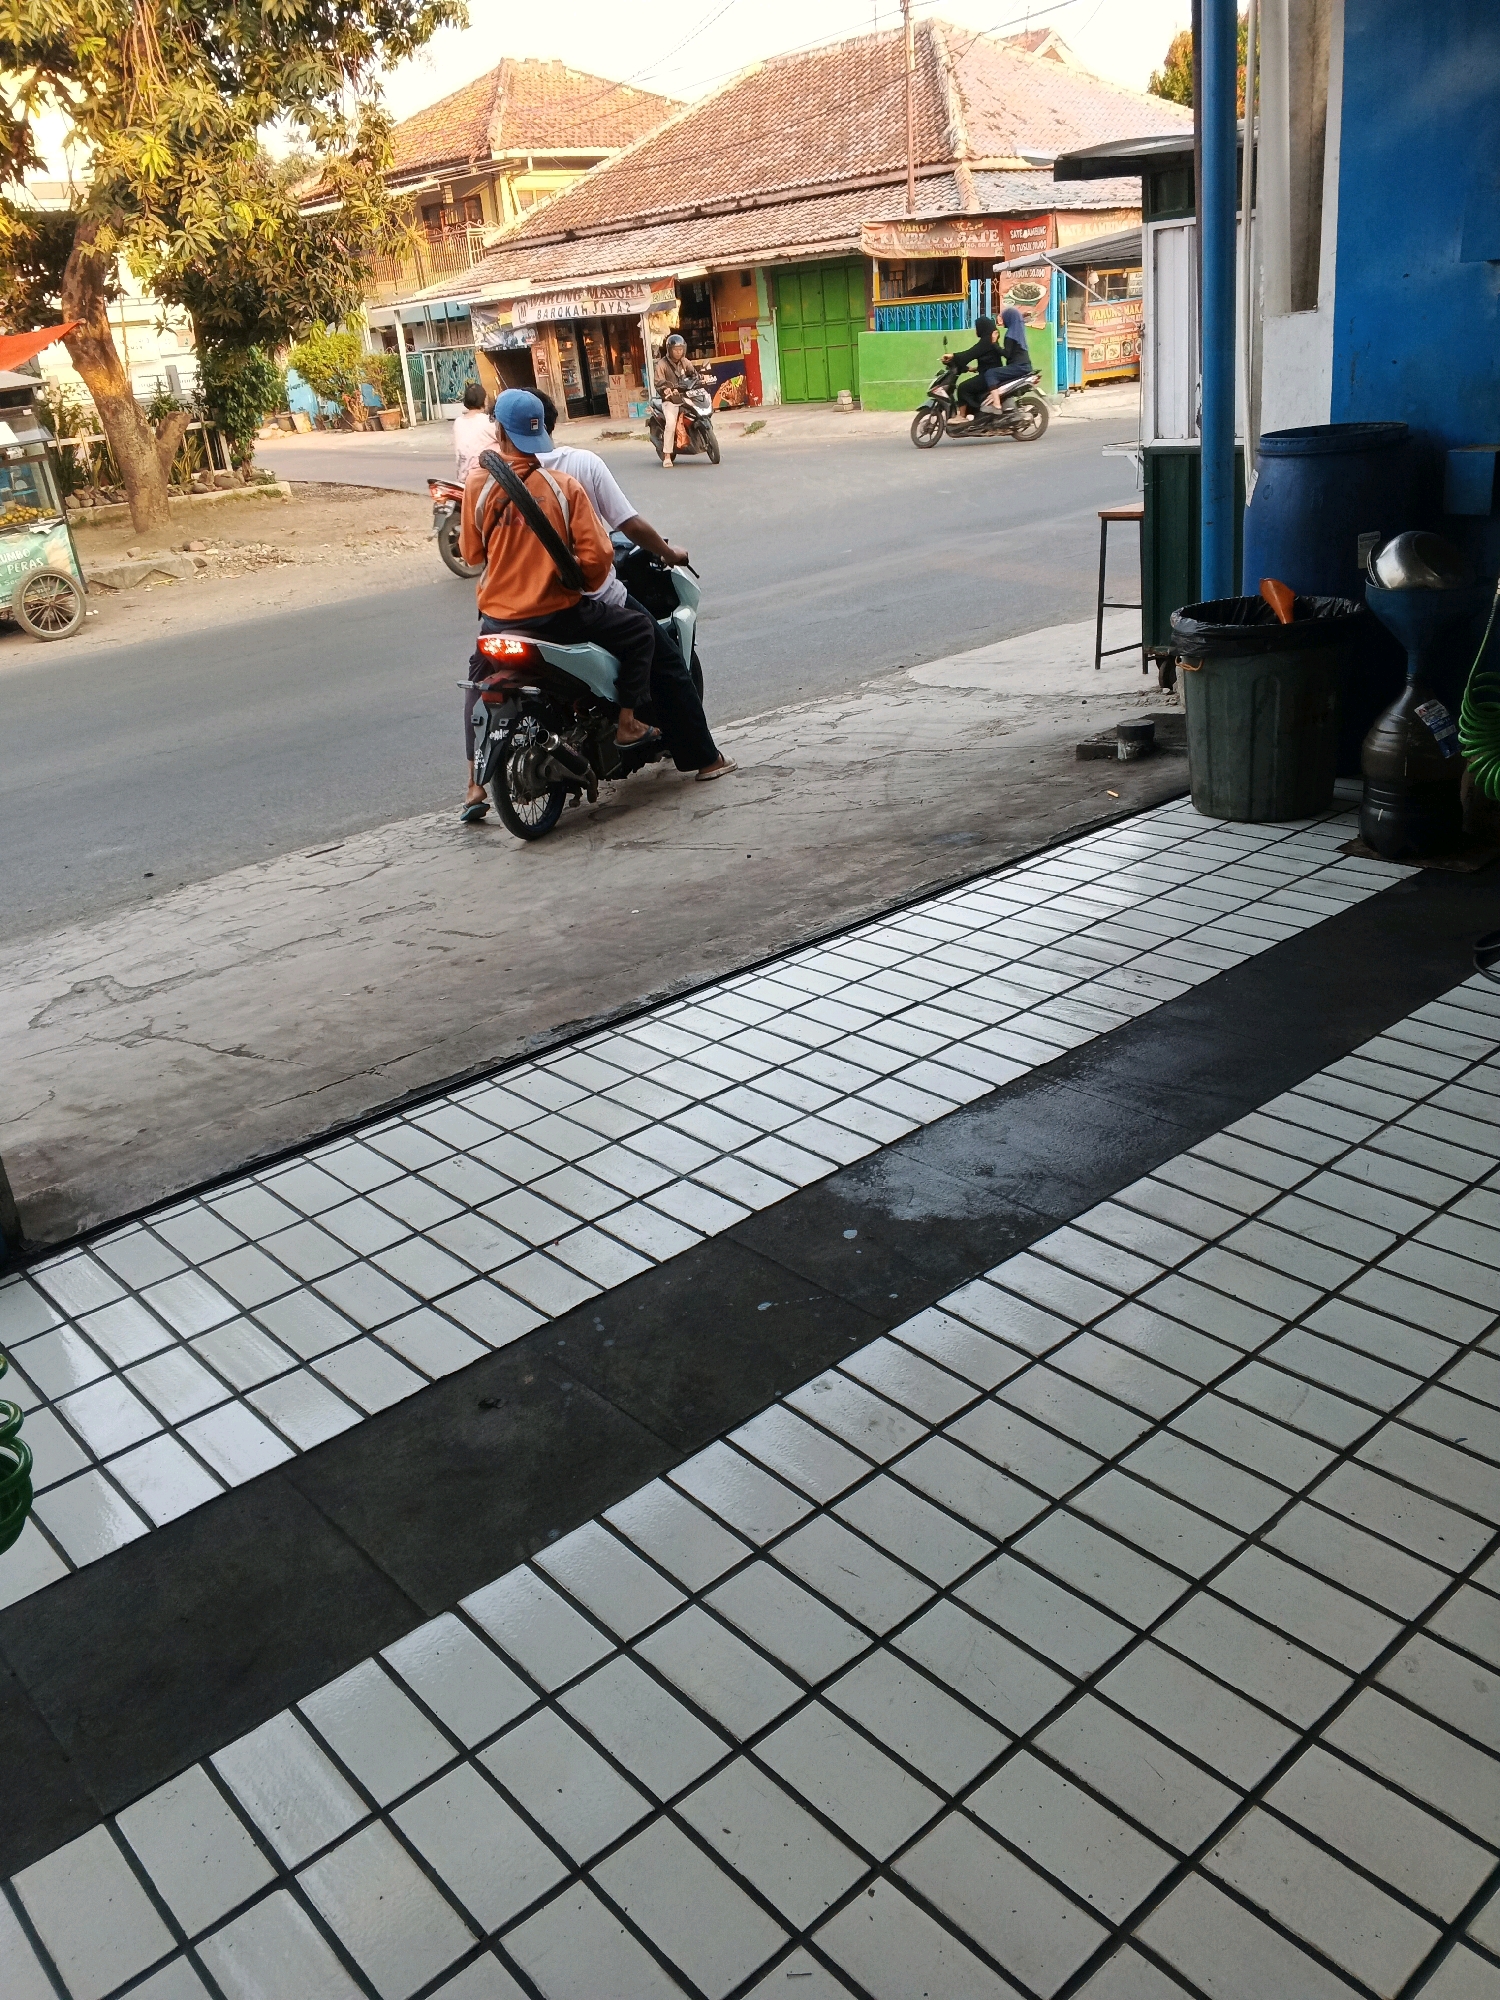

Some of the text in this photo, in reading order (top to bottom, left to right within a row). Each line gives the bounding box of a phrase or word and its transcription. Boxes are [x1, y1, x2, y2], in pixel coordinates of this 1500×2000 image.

[897, 223, 937, 233] WARUN
[1009, 225, 1047, 239] SATE AMBING
[957, 229, 1000, 243] SATE
[536, 305, 588, 320] BAROKAH
[592, 302, 623, 315] JAYA
[7, 557, 45, 575] PERAS
